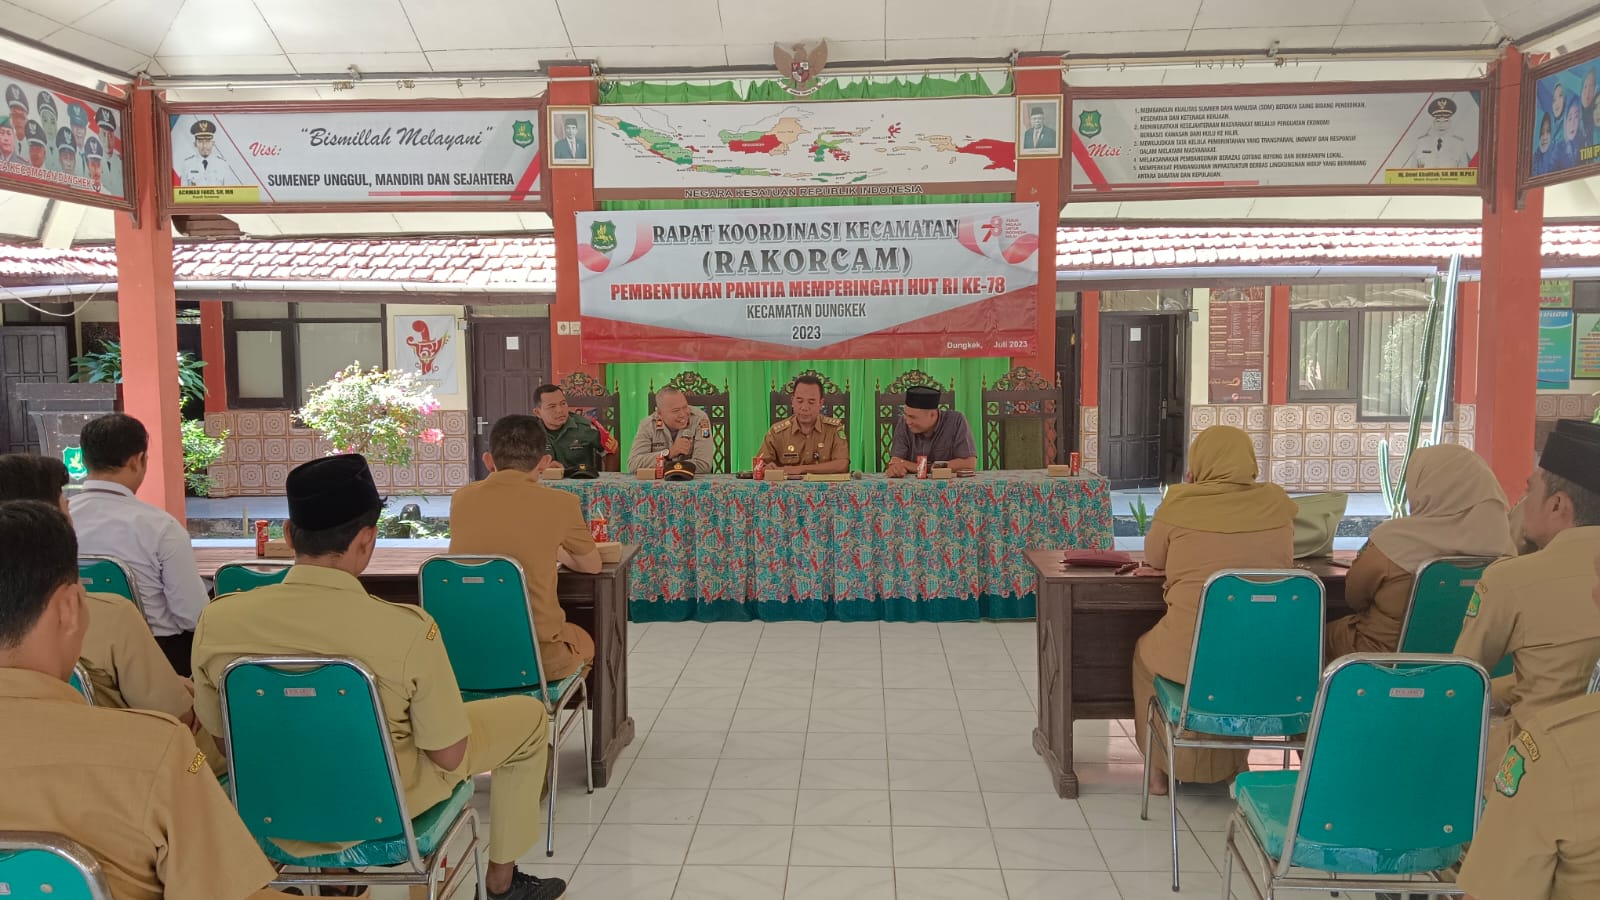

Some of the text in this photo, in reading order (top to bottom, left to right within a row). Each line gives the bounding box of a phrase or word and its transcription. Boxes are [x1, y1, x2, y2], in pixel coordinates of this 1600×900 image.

[249, 142, 281, 156] Visi:
[1088, 144, 1121, 157] Misi
[10, 162, 56, 181] KECAMATAN
[267, 173, 514, 187] SUMENEP UNGGUL, MANDIRI DAN SEJAHTERA
[685, 185, 923, 198] NEGARA KESATUAN REPUBLIK INDONESIA
[652, 219, 960, 243] RAPAT KOORDINASI KECAMATAN
[702, 247, 912, 278] (RAKORCAM)
[610, 276, 1006, 300] PEMBENTUKAN PANITIA MEMPERINGATI HUT RI KE-78
[747, 302, 867, 319] KECAMATAN DUNGKEK
[792, 326, 821, 340] 2023
[946, 342, 983, 350] Dungkek,
[1009, 340, 1028, 348] 2023
